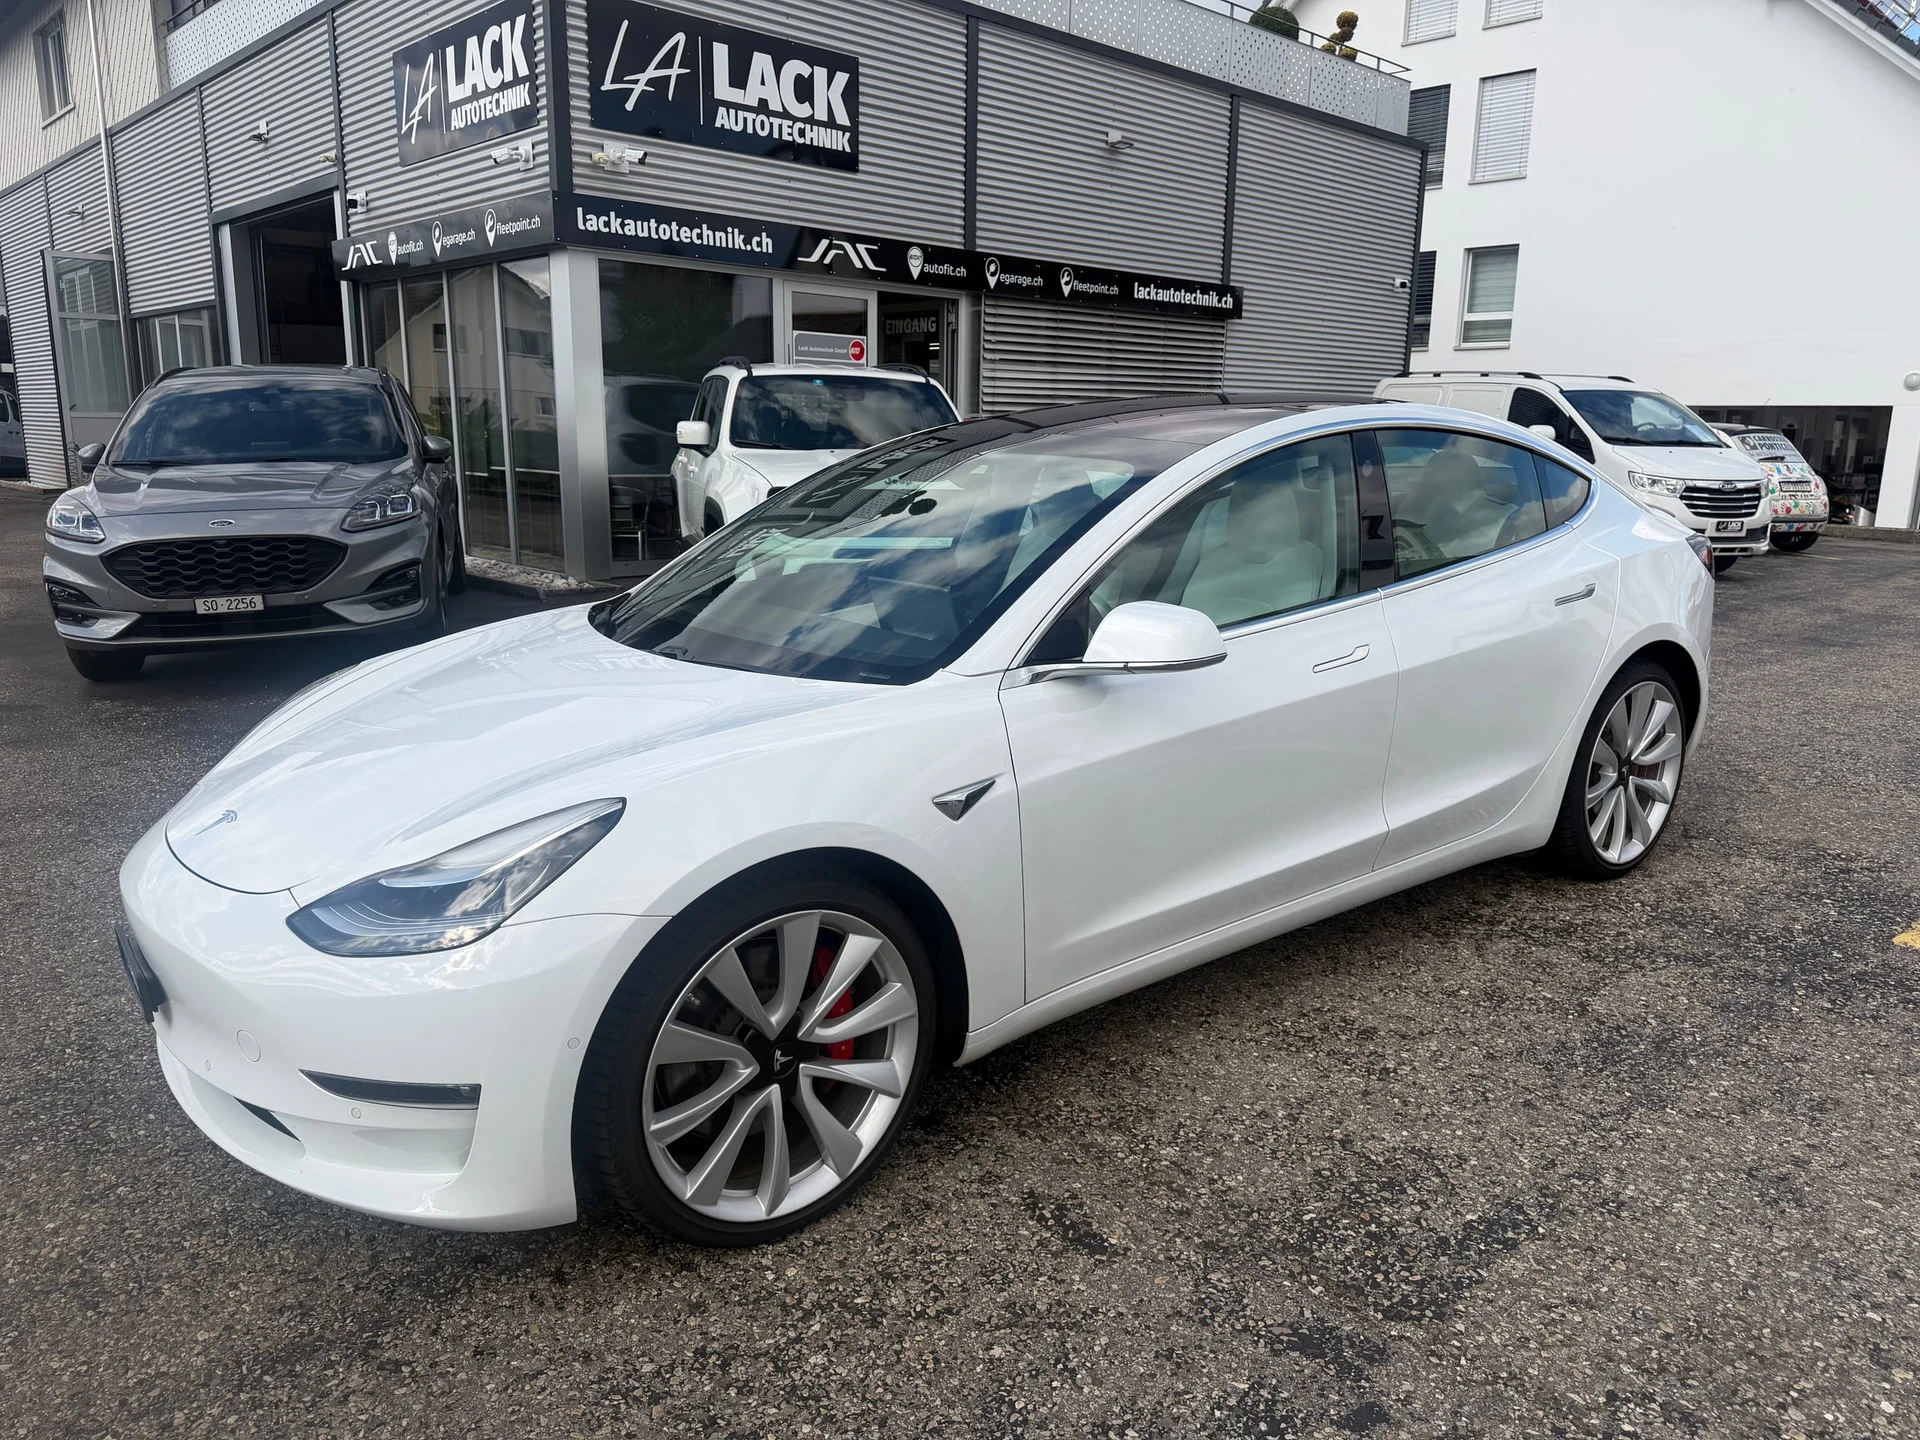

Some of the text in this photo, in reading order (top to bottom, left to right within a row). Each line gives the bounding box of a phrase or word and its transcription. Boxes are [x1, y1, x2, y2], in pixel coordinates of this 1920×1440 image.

[445, 13, 530, 104] LACK
[600, 19, 691, 112] LA
[712, 41, 852, 127] LACK
[400, 52, 438, 145] LA
[450, 82, 532, 131] AUTOTECHNIK
[714, 106, 852, 153] AUTOTECHNIK
[442, 229, 476, 248] egarage.ch
[496, 214, 541, 236] fleetpoint.ch
[576, 206, 773, 254] lackautotechnik.ch
[397, 239, 424, 255] autofit.ch
[923, 262, 967, 278] autofit.ch
[999, 271, 1043, 287] egarage.ch
[1073, 280, 1119, 296] fleetpoint.ch
[1133, 281, 1234, 309] lackautotechnik.ch
[885, 316, 937, 335] EINGANG
